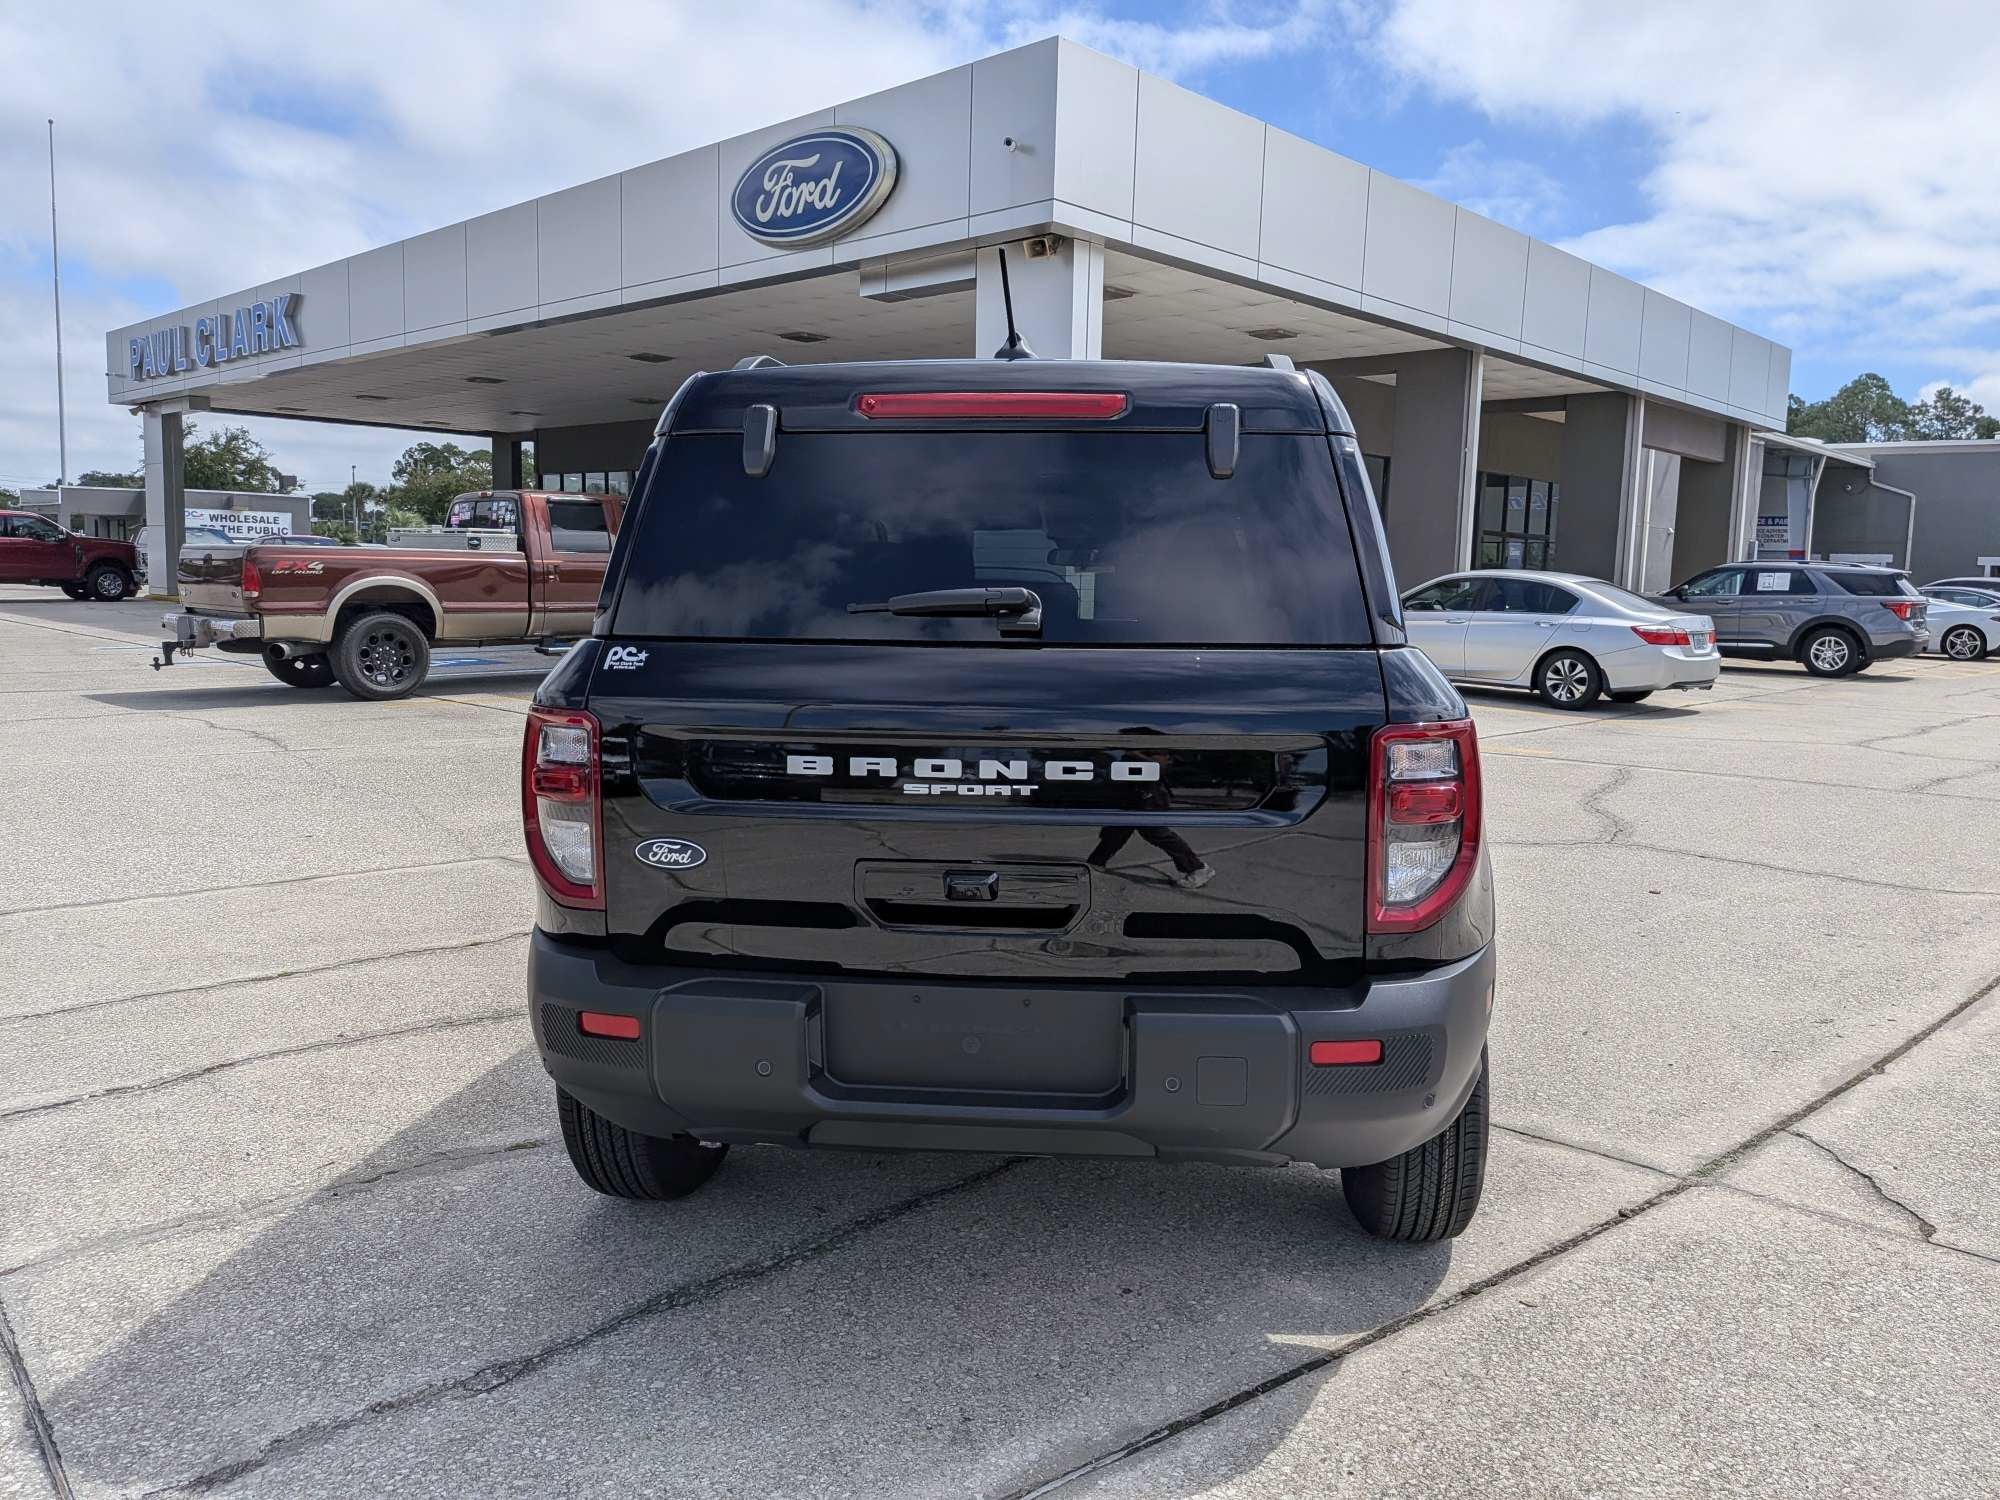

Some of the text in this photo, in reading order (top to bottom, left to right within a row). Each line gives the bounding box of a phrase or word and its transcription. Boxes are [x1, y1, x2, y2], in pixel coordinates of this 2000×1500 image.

[755, 153, 844, 223] Ford
[129, 294, 297, 380] PAUL CLARK
[208, 513, 280, 525] WHOLESALE
[220, 525, 243, 534] THE
[247, 527, 289, 536] PUBLIC
[273, 560, 325, 570] FX4
[786, 755, 1160, 781] BRONCO
[903, 784, 1038, 796] SPORT
[648, 843, 692, 864] Ford
